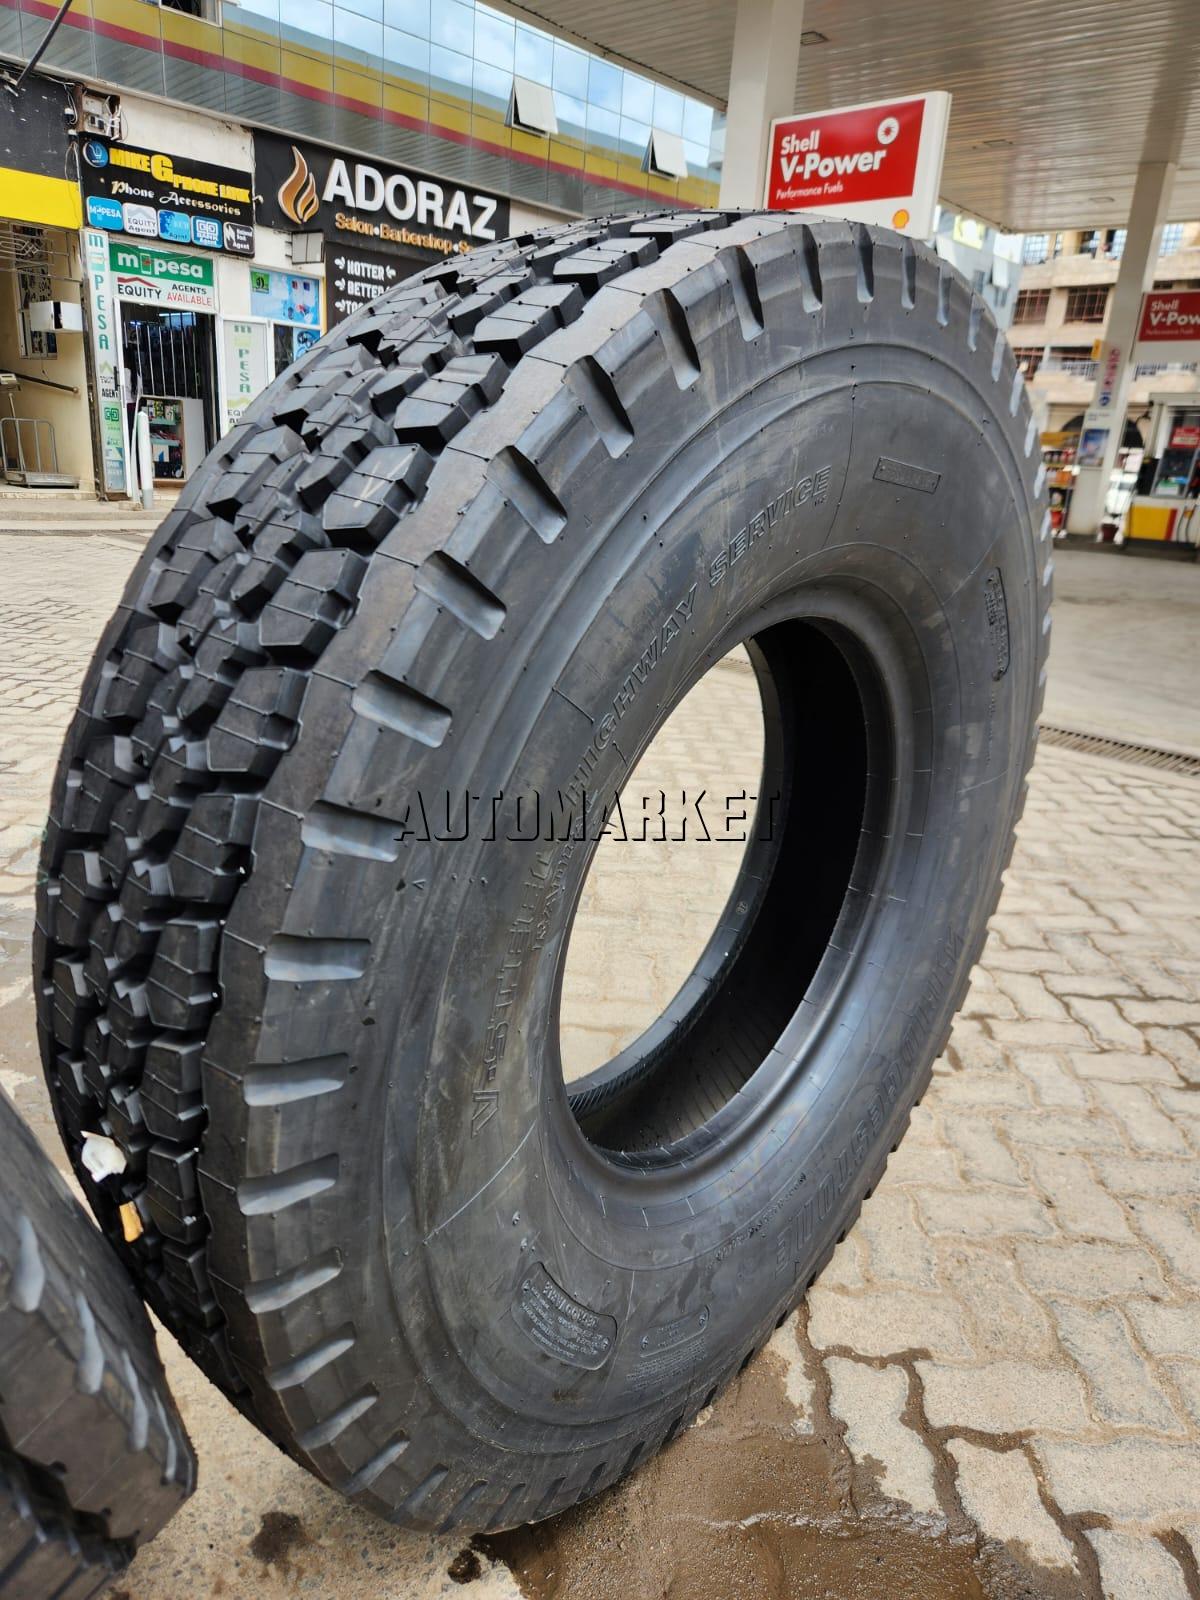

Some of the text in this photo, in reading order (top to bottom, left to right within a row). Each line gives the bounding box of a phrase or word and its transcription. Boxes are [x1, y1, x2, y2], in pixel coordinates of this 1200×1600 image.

[780, 129, 820, 155] Shell
[109, 148, 151, 172] MIKE
[780, 149, 887, 183] V-Power
[111, 180, 241, 216] Phone Accessories
[322, 158, 497, 240] ADORAZ
[776, 180, 844, 200] Performance Fuels
[127, 217, 156, 228] EQUITY
[335, 212, 374, 236] Salon
[379, 222, 453, 256] Barbershop
[346, 259, 385, 281] HOTTER
[117, 284, 162, 300] EQUITY
[167, 292, 212, 306] AVAILABLE
[171, 283, 207, 295] AGENTS
[1152, 300, 1179, 311] Shell
[563, 582, 699, 807] HIGHWAY
[709, 464, 833, 589] SERVICE
